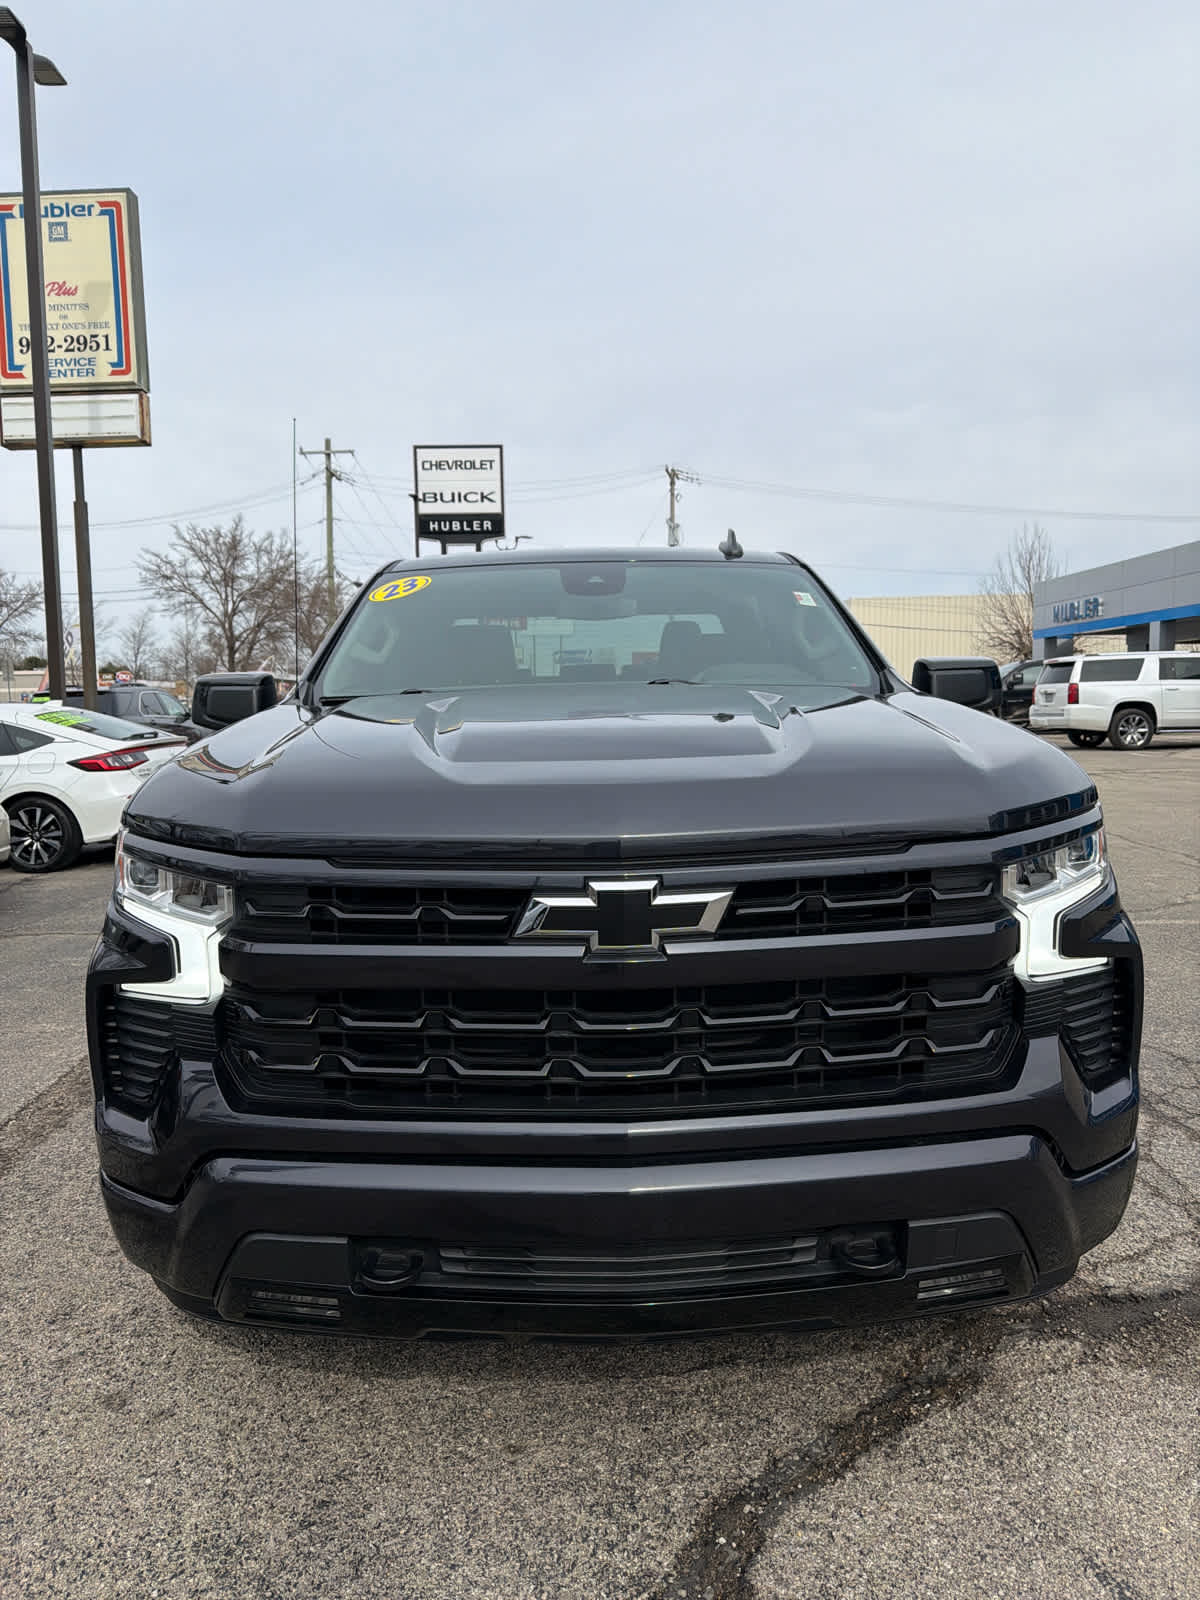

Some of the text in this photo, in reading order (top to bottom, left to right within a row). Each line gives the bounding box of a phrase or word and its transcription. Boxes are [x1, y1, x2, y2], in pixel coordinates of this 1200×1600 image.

[46, 280, 79, 297] Plus
[48, 303, 89, 312] MINUTES
[87, 320, 110, 329] FREE
[19, 334, 112, 355] 92-2951
[48, 357, 96, 368] ERVICE
[48, 368, 95, 378] ENTER
[422, 459, 495, 471] CHEVROLET
[422, 491, 496, 503] BUICK
[429, 520, 492, 532] HUBLER
[383, 579, 418, 599] 23
